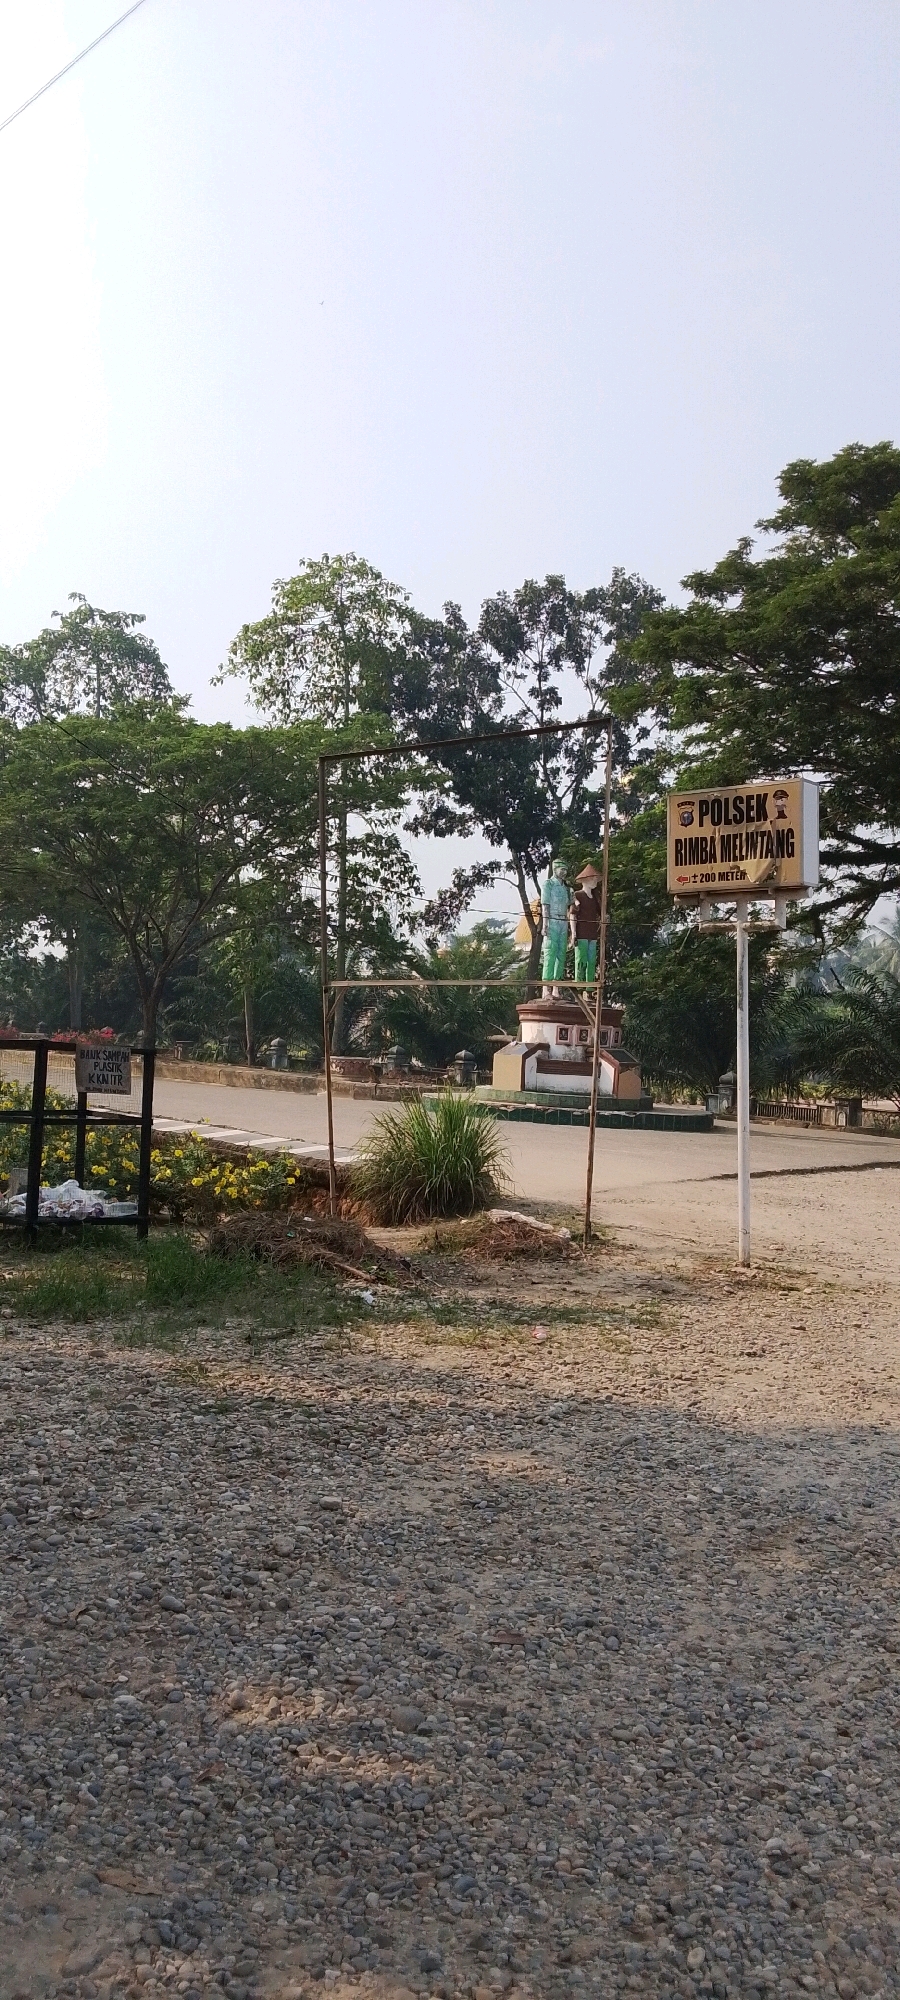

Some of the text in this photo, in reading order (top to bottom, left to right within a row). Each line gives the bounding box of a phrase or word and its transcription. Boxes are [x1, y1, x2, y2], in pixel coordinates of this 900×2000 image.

[698, 793, 769, 827] POLSEK
[675, 828, 795, 867] RIMBA MELINTANG
[718, 871, 746, 882] METER
[80, 1050, 130, 1062] BANK SAMPAH
[94, 1062, 122, 1073] PLASTIK
